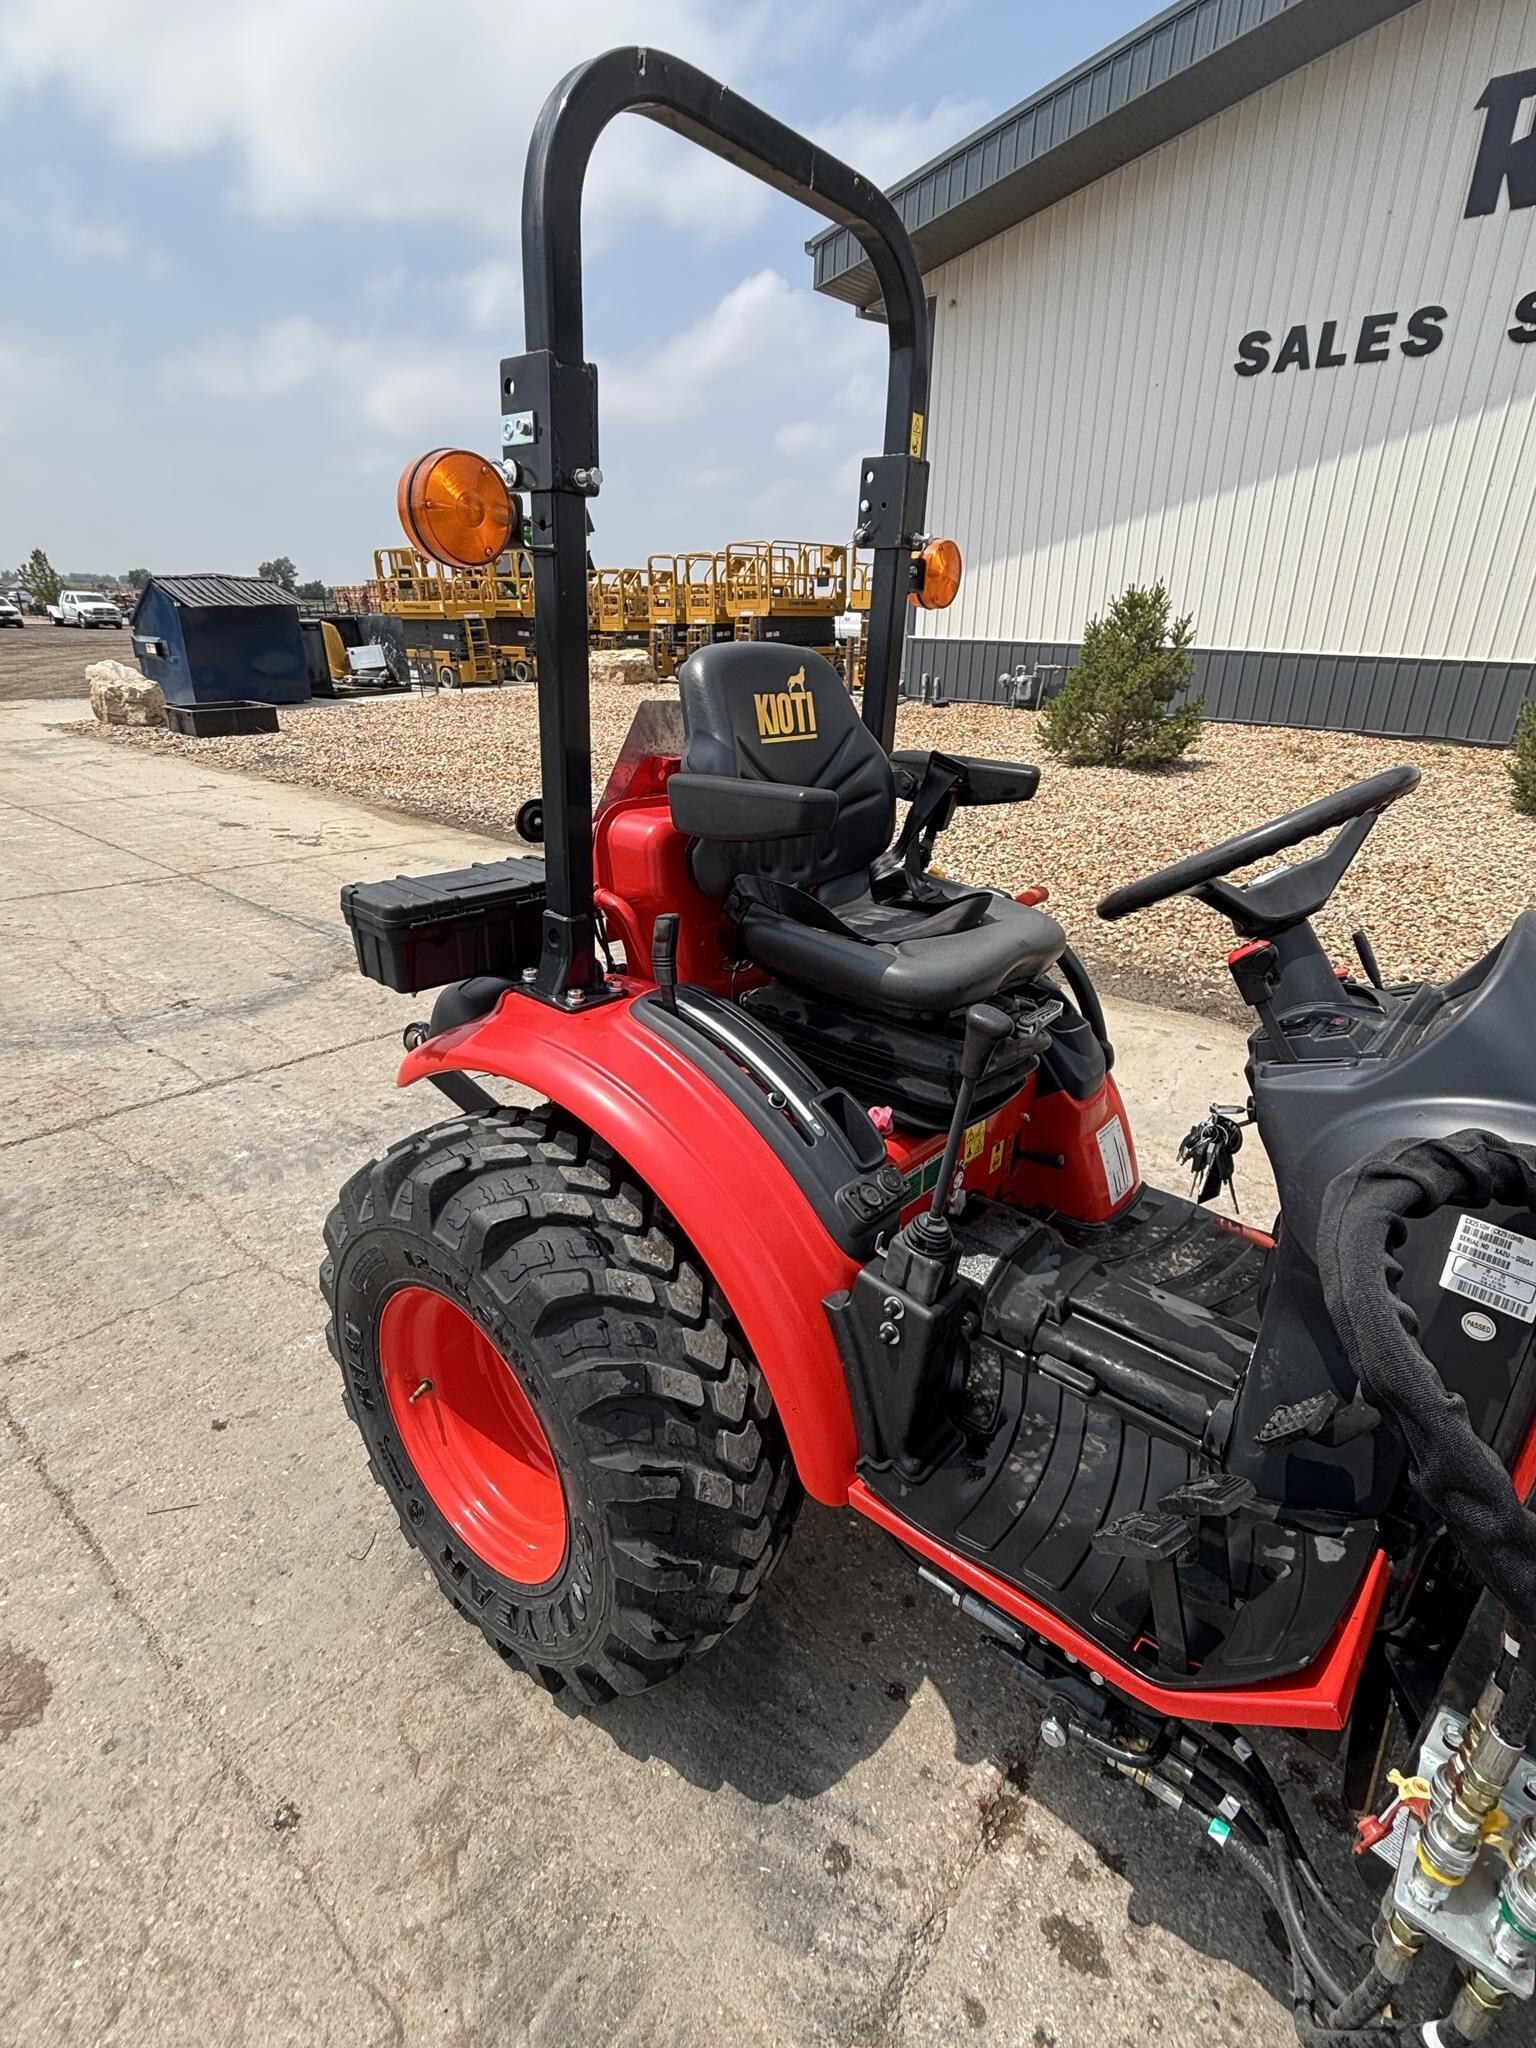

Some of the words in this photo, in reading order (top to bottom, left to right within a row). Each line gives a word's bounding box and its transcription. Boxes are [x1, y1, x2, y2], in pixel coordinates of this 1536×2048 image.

[1233, 305, 1448, 377] SALES
[753, 691, 817, 736] KIOTI
[1459, 1234, 1479, 1247] SERIAL
[1466, 1319, 1491, 1334] PASSED
